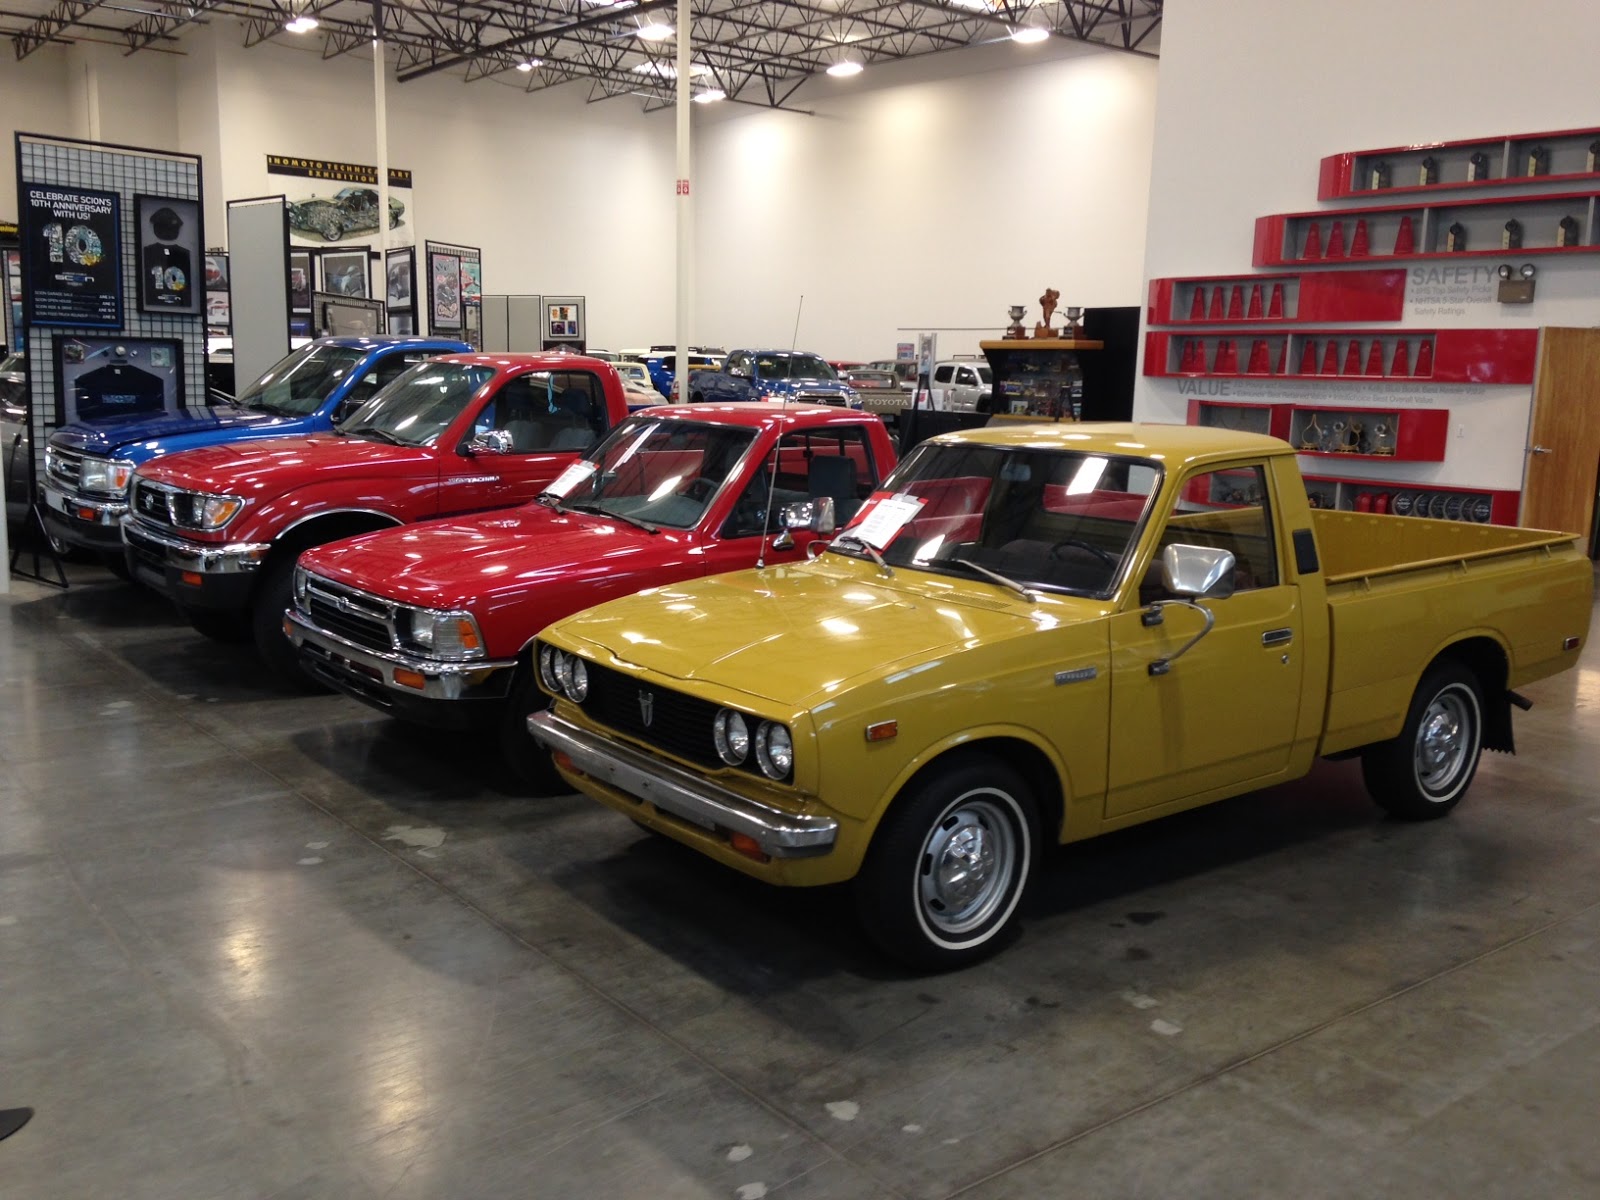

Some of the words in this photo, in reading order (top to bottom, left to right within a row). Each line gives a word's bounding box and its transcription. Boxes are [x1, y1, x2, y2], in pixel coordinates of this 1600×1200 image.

[268, 157, 323, 169] INOMOTO
[390, 170, 410, 179] ART
[308, 169, 375, 183] EXHIBITION
[29, 190, 79, 203] CELEBRATE
[80, 196, 112, 207] SCION'S
[30, 199, 51, 208] 10TH
[52, 202, 112, 214] ANNIVERSARY
[53, 209, 76, 219] WITH
[76, 212, 91, 220] US!
[1412, 265, 1498, 286] SAFETY
[1414, 307, 1436, 317] Safety
[1437, 307, 1466, 316] Ratings
[1177, 380, 1231, 396] VALUE
[868, 398, 908, 406] TOYOTA
